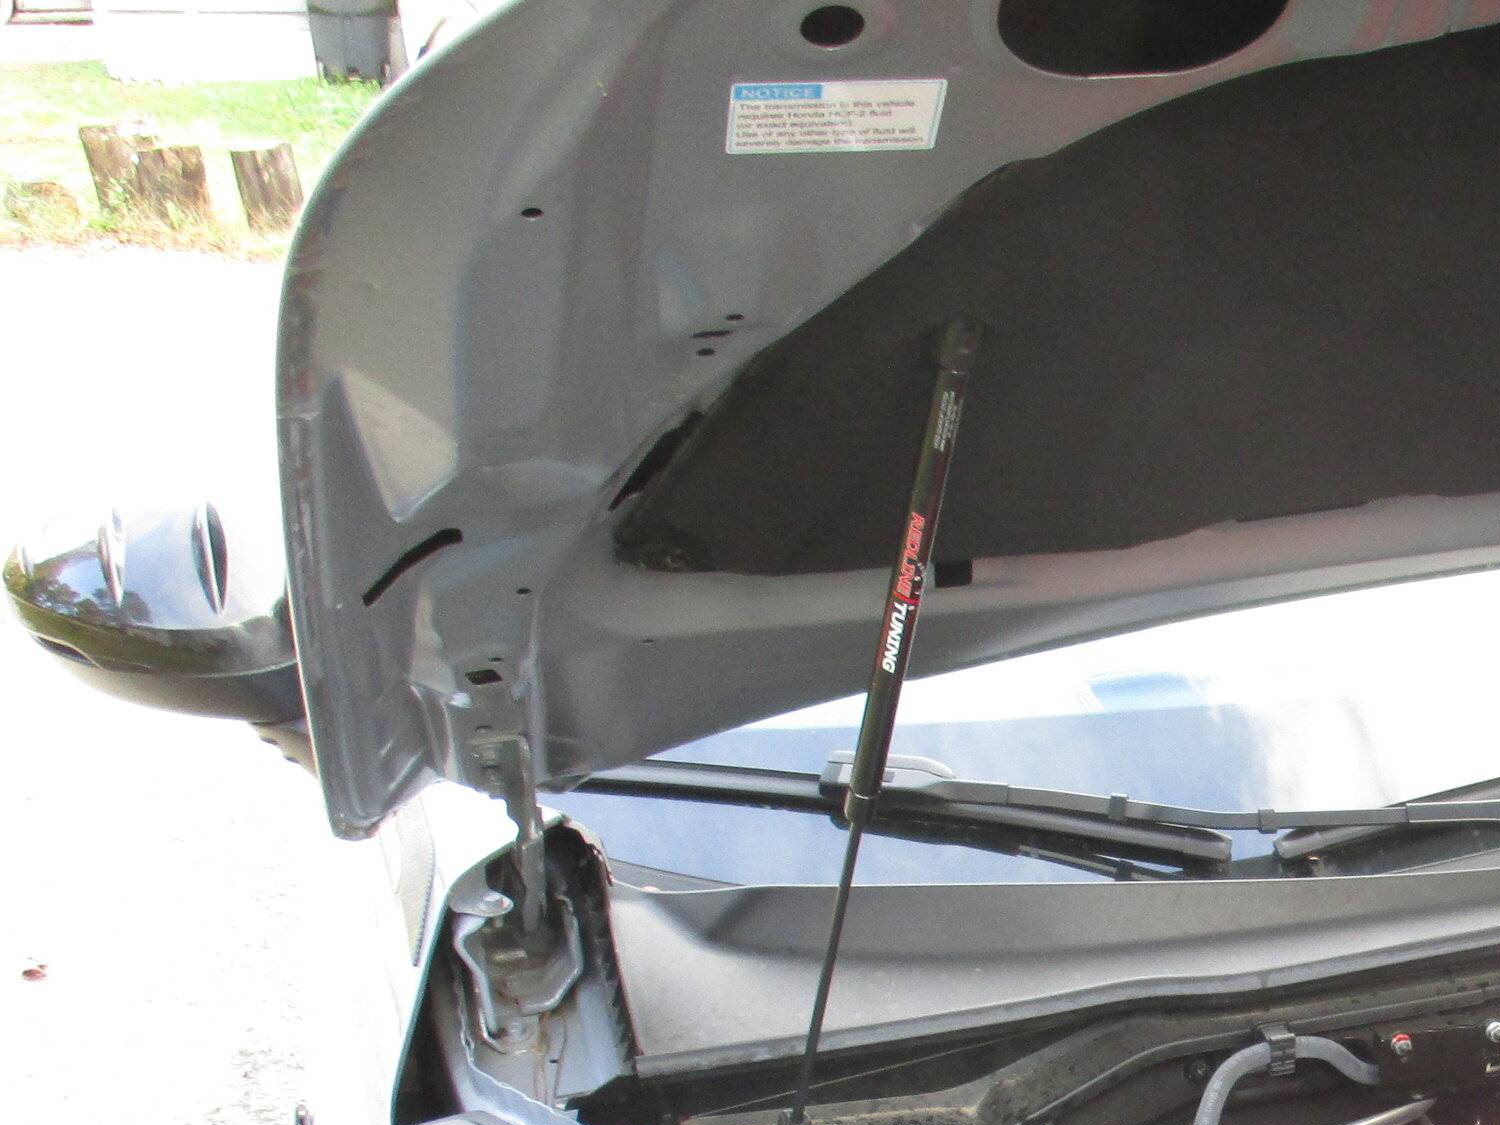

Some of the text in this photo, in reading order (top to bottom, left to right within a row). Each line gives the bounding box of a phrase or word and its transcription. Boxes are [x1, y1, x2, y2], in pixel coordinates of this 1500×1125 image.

[741, 87, 816, 99] NOTICE
[895, 511, 925, 598] REDLINE
[882, 602, 908, 674] TUNING
